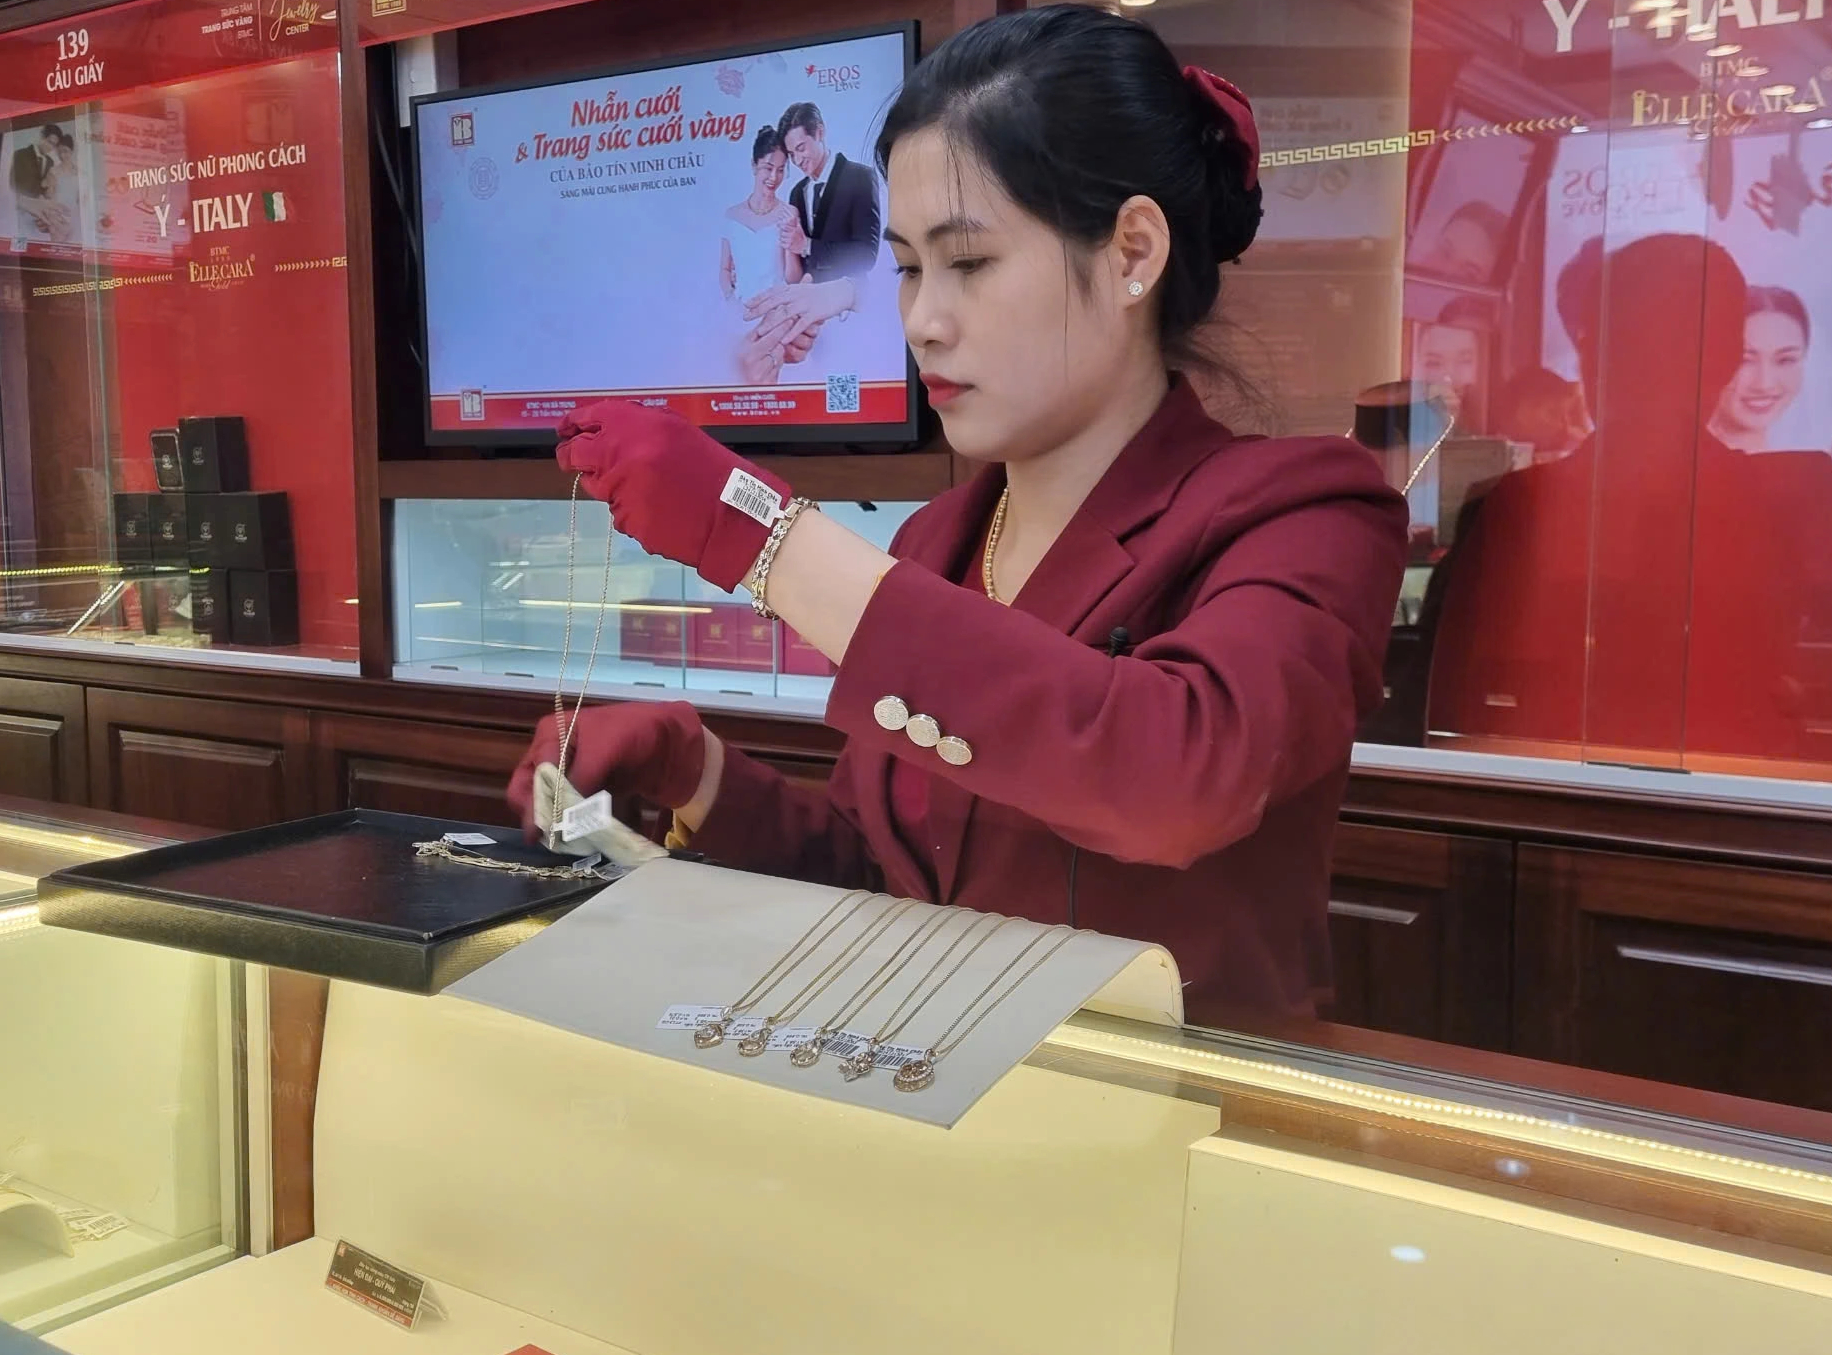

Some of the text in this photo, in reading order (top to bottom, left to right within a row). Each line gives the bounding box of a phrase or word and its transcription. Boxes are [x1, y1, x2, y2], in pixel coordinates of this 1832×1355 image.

[57, 28, 89, 61] 139
[201, 23, 221, 34] TRANG
[285, 23, 310, 36] CENTER
[46, 54, 105, 92] CẦU GIẤY
[817, 64, 861, 85] EROS
[570, 85, 682, 128] Nhẫn cưới
[514, 110, 747, 163] & Trang sức cưới vàng
[127, 141, 307, 189] TRANG SỨC NỮ PHONG CÁCH
[606, 160, 627, 176] TÍN
[630, 158, 664, 174] MINH
[668, 151, 705, 170] CHÂU
[154, 194, 171, 237] Ý
[192, 192, 253, 234] ITALY
